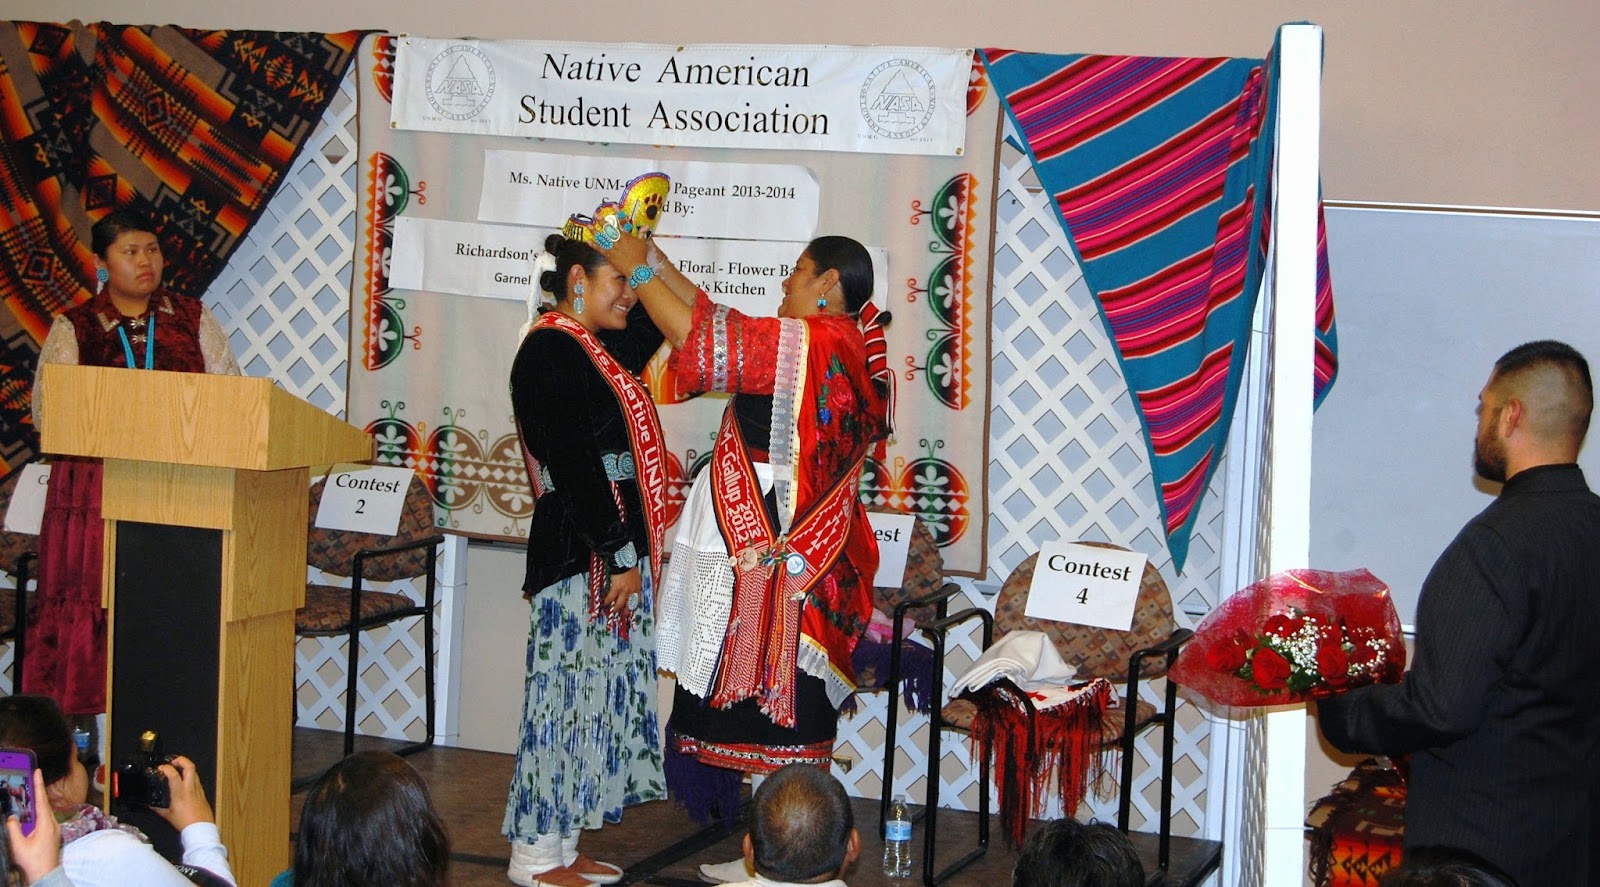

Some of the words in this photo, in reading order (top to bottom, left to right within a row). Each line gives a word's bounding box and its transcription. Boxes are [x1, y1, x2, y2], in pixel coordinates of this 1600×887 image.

[540, 53, 641, 83] Native
[656, 55, 810, 88] American
[434, 80, 485, 96] NASA
[518, 94, 631, 128] Student
[646, 100, 830, 136] Association
[869, 94, 925, 113] NASA
[509, 171, 532, 185] Ms.
[536, 174, 580, 189] Native
[674, 183, 726, 199] Pageant
[732, 185, 795, 199] 2013-2014
[674, 201, 695, 218] By:
[456, 242, 539, 263] Richardson's
[679, 260, 716, 274] Floral
[728, 262, 776, 277] Flower
[779, 264, 796, 277] Ba
[494, 272, 531, 286] Garnel
[713, 281, 766, 296] Kitchen
[614, 373, 651, 443] Native
[336, 473, 400, 493] Contest
[355, 499, 366, 514] 2
[728, 504, 751, 544] 2012
[740, 501, 761, 539] 2013
[875, 527, 901, 542] est
[1048, 554, 1131, 582] Contest
[1076, 587, 1089, 605] 4
